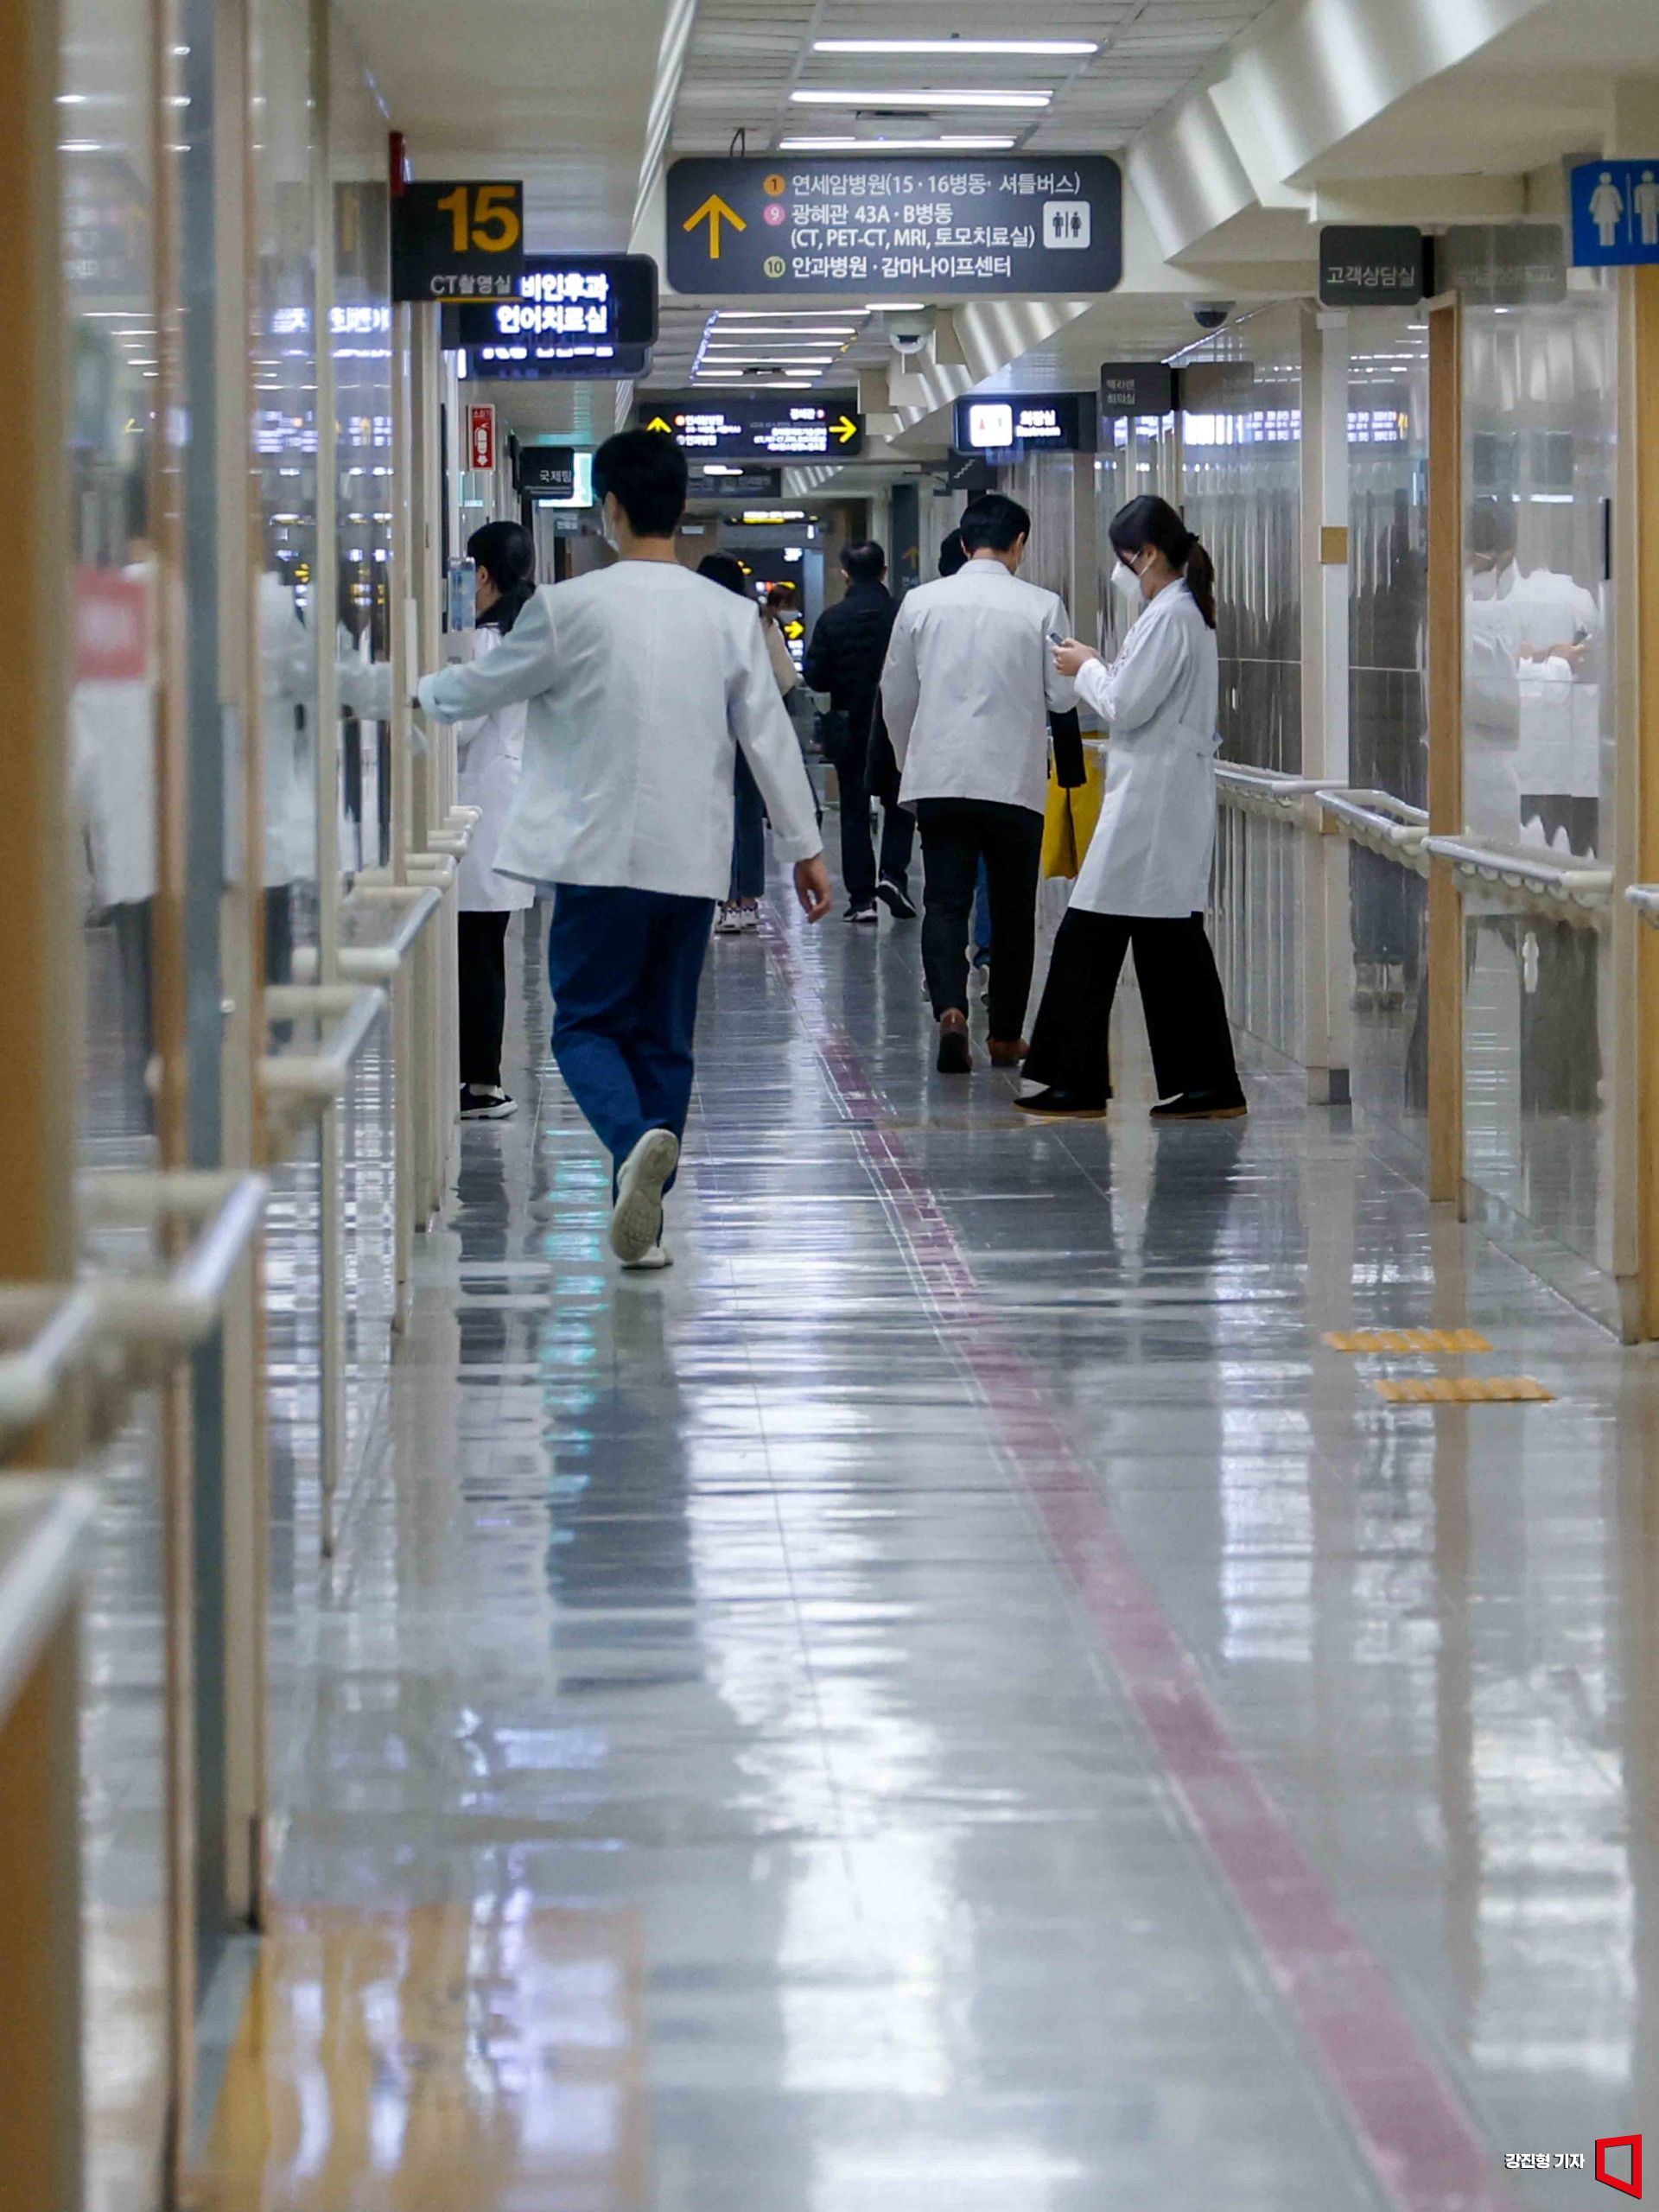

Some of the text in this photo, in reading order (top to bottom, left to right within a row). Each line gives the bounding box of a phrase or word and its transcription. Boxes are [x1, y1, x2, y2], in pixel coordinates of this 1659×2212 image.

[999, 172, 1081, 195] 셔틀버스)
[437, 185, 520, 253] 15
[791, 203, 849, 226] 광혜관
[791, 225, 1036, 251] (CT, PET-CT, MRI, 토모치료실)
[1326, 265, 1415, 288] 고객상담실
[497, 304, 608, 334] 언어치료실
